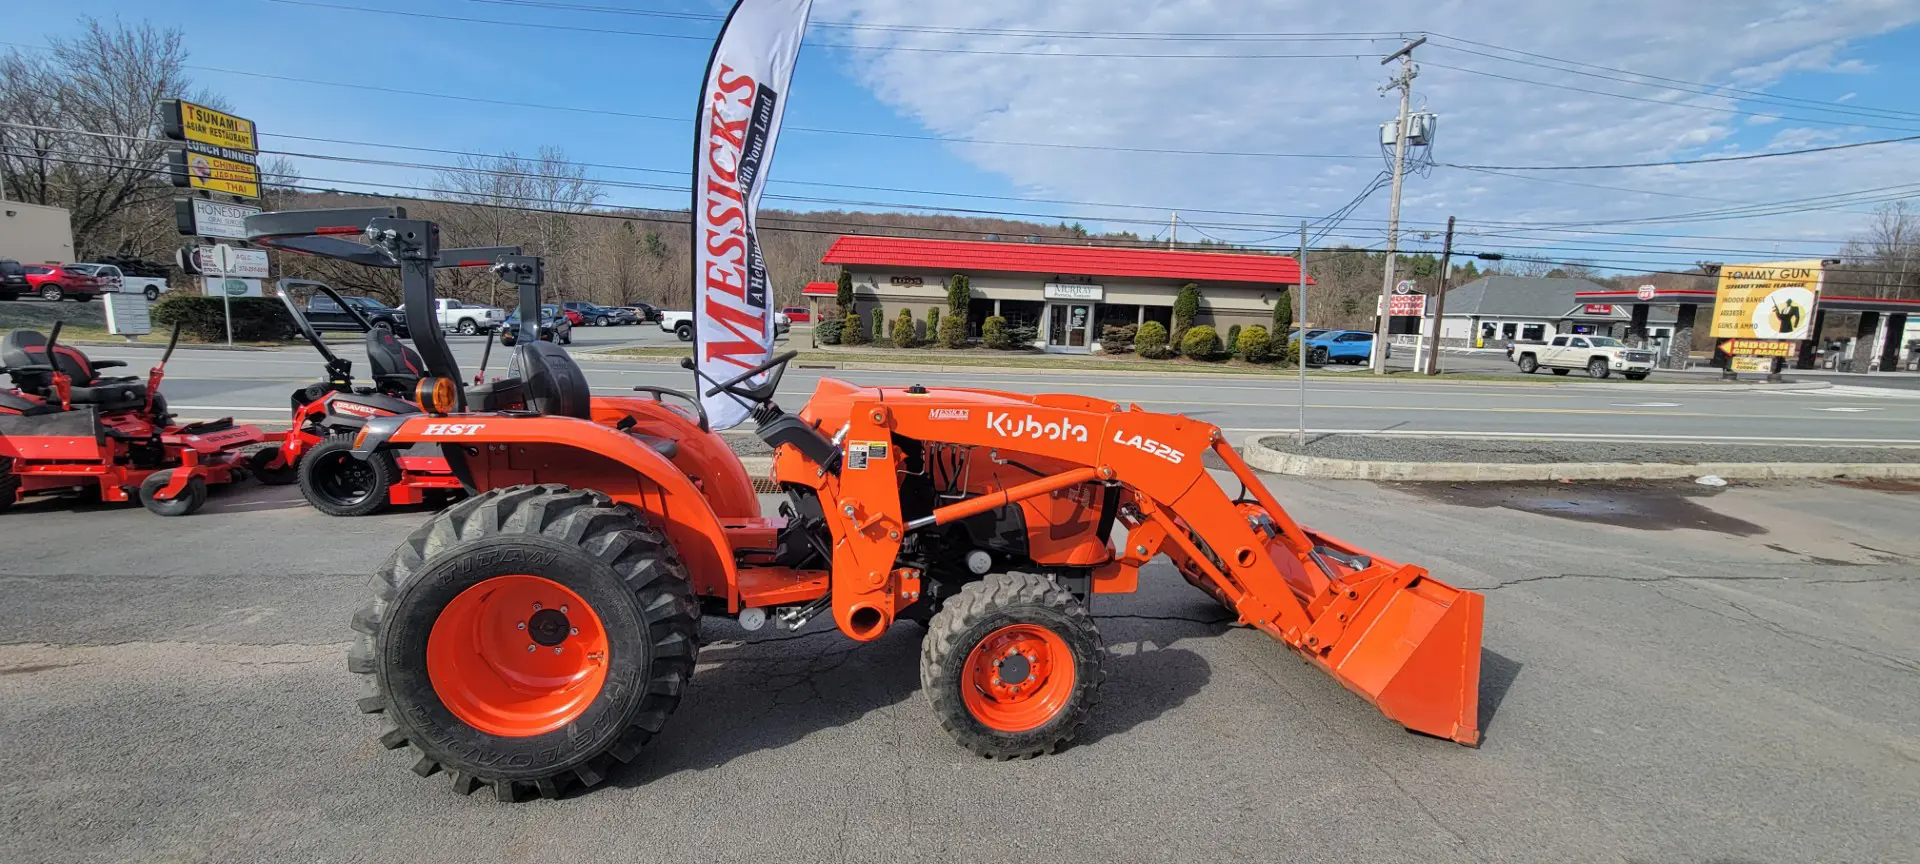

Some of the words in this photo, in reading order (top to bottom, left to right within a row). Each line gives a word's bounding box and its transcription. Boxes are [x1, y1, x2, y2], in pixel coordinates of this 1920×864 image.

[187, 105, 238, 131] TSUNAMI
[755, 95, 773, 129] Land
[185, 121, 207, 133] ASIAN
[210, 126, 249, 144] RESTAURANT
[187, 139, 220, 155] LUNCH
[222, 148, 255, 164] DINNER
[747, 133, 764, 164] Your
[213, 159, 252, 174] CHINESE
[226, 182, 247, 193] THAI
[738, 166, 754, 194] With
[197, 203, 257, 218] HONESDA
[706, 63, 767, 376] MESSICK'S
[751, 241, 765, 289] Helpin
[1727, 269, 1775, 281] TOMMY
[1779, 268, 1811, 279] GUN
[751, 292, 762, 303] A
[1055, 284, 1092, 293] MURRAY
[1739, 322, 1758, 330] AMMO
[1733, 340, 1789, 350] INDOOR
[1754, 349, 1788, 357] RANGE
[336, 402, 377, 414] GRAVELY
[421, 423, 485, 436] HST
[986, 411, 1089, 443] Kubota
[1113, 429, 1185, 465] LA525
[437, 548, 558, 584] TITAN
